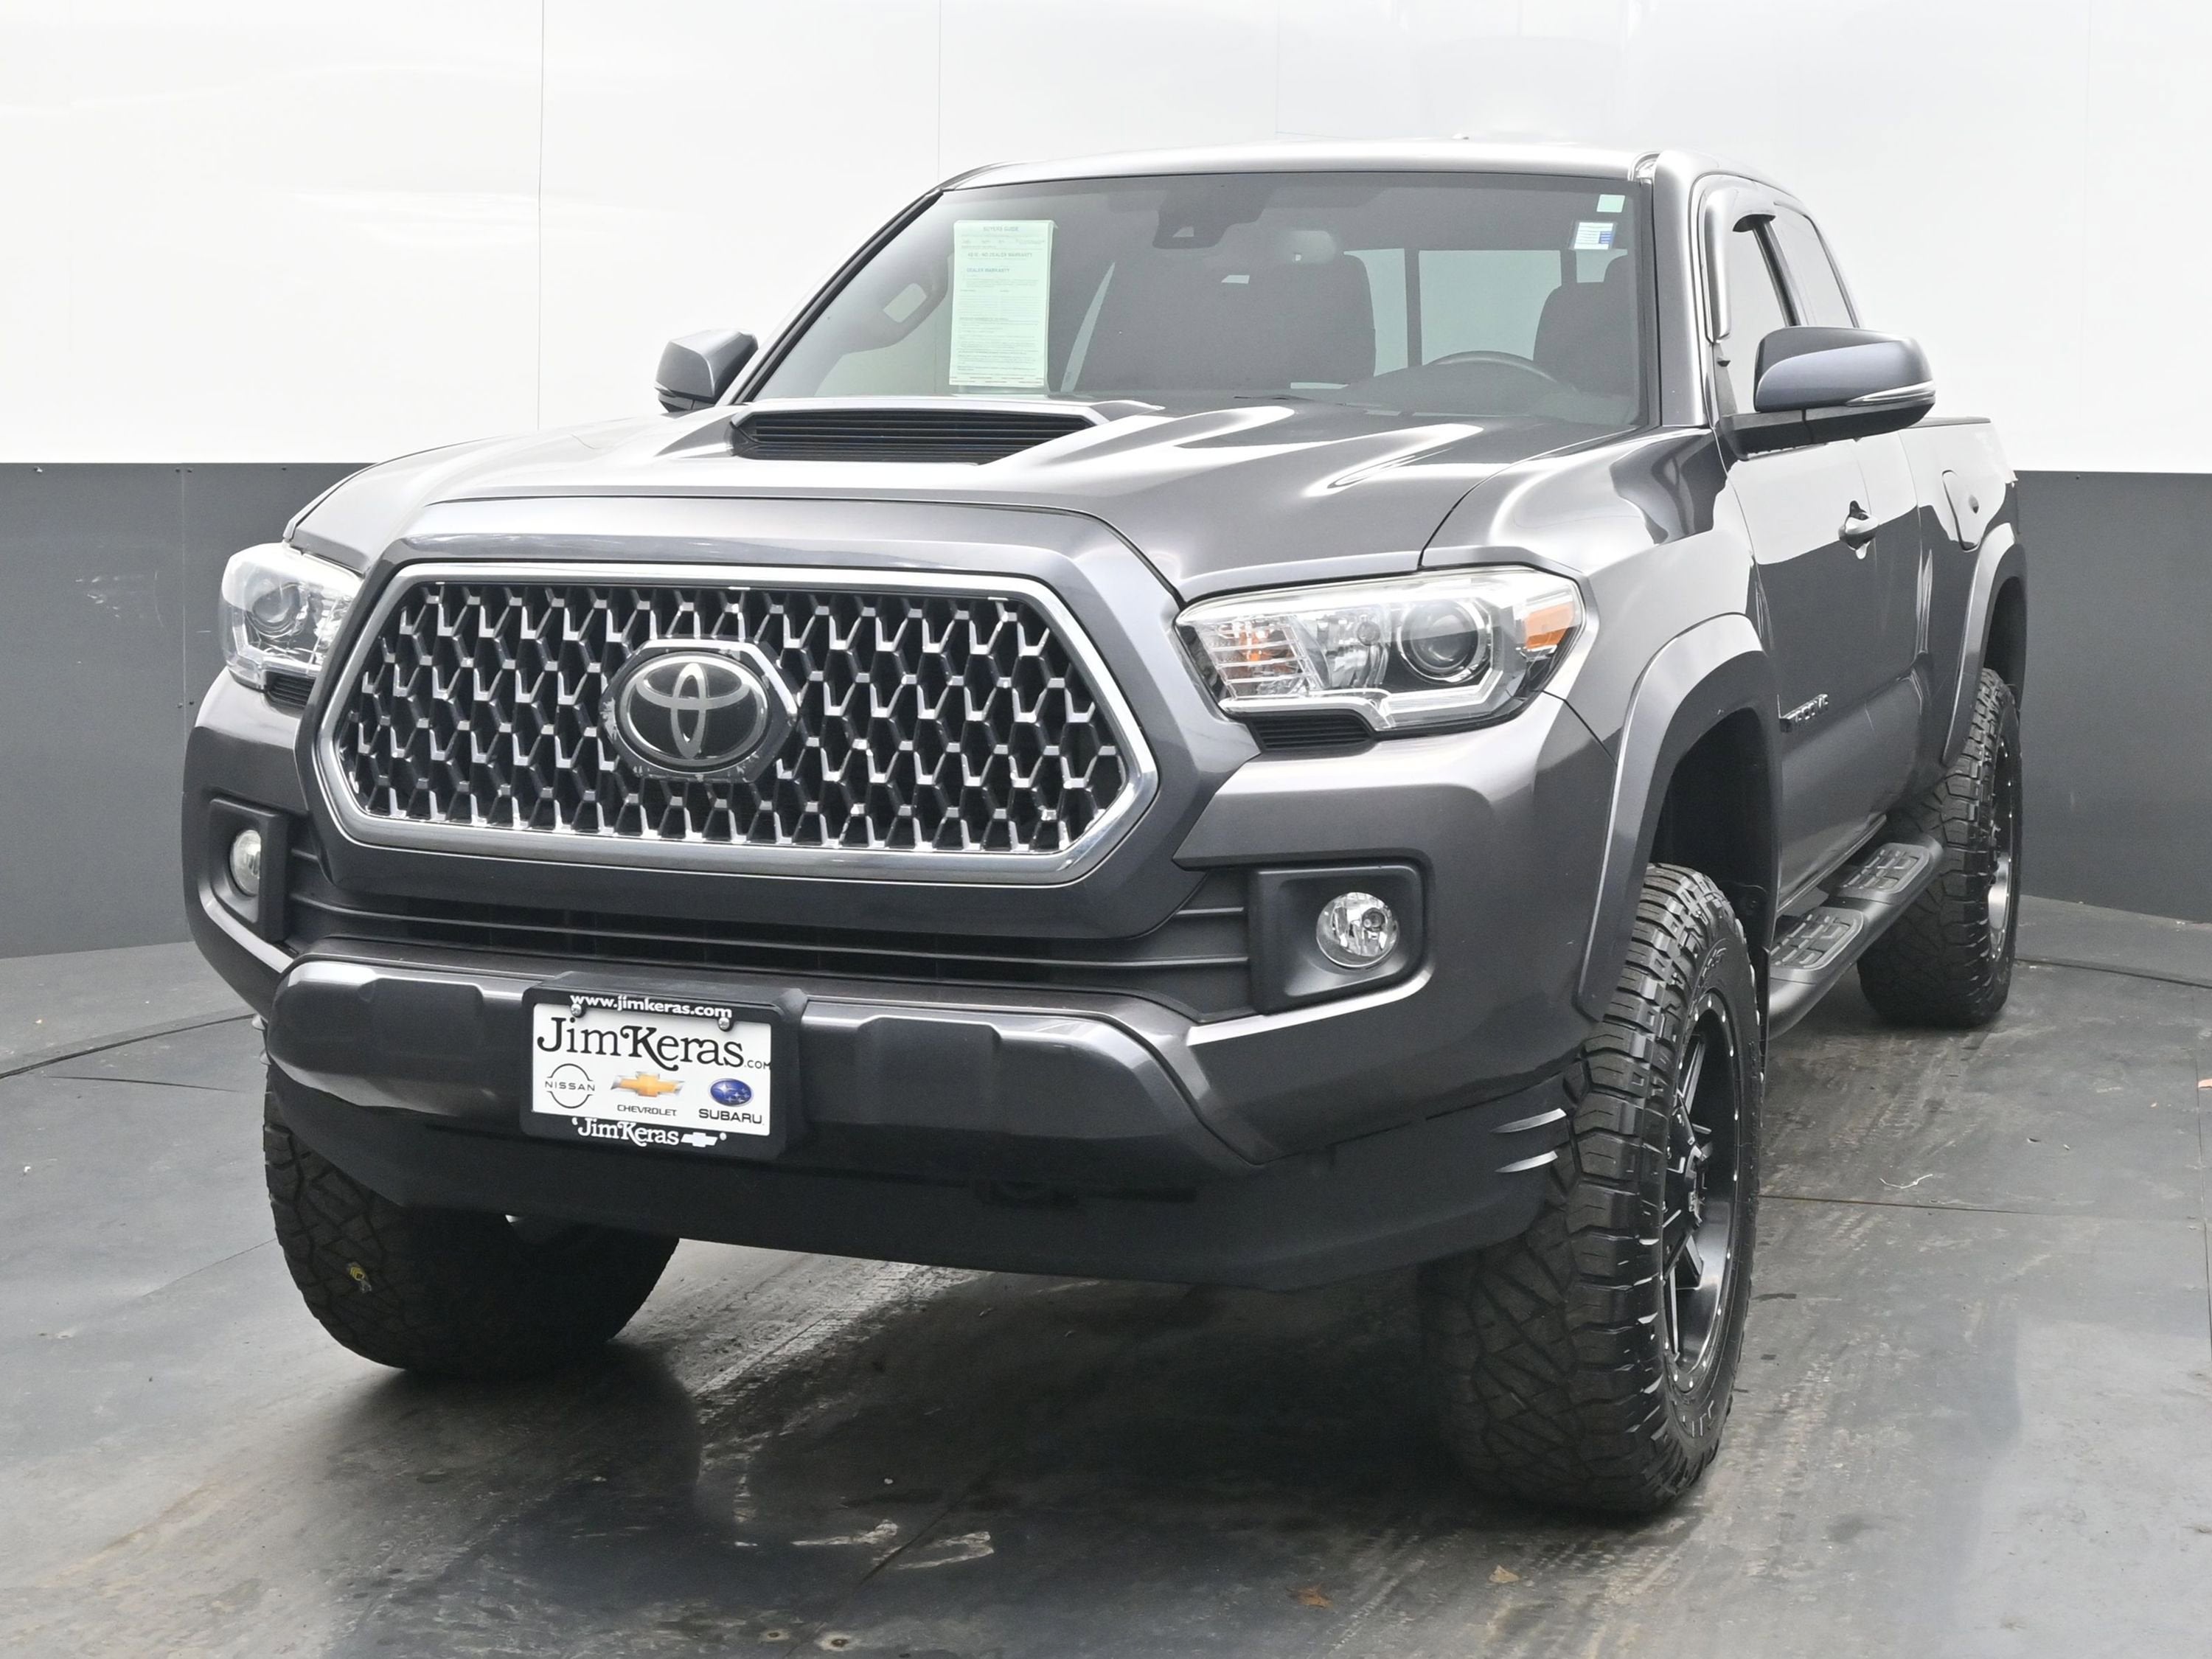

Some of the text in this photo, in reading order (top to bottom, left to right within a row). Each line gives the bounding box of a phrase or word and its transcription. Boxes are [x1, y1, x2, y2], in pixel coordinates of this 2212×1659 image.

[570, 995, 732, 1019] www.jimkeras.com
[545, 1080, 596, 1092] NISSAN
[617, 1104, 677, 1116] CHEVROLET
[698, 1108, 763, 1124] SUBARU
